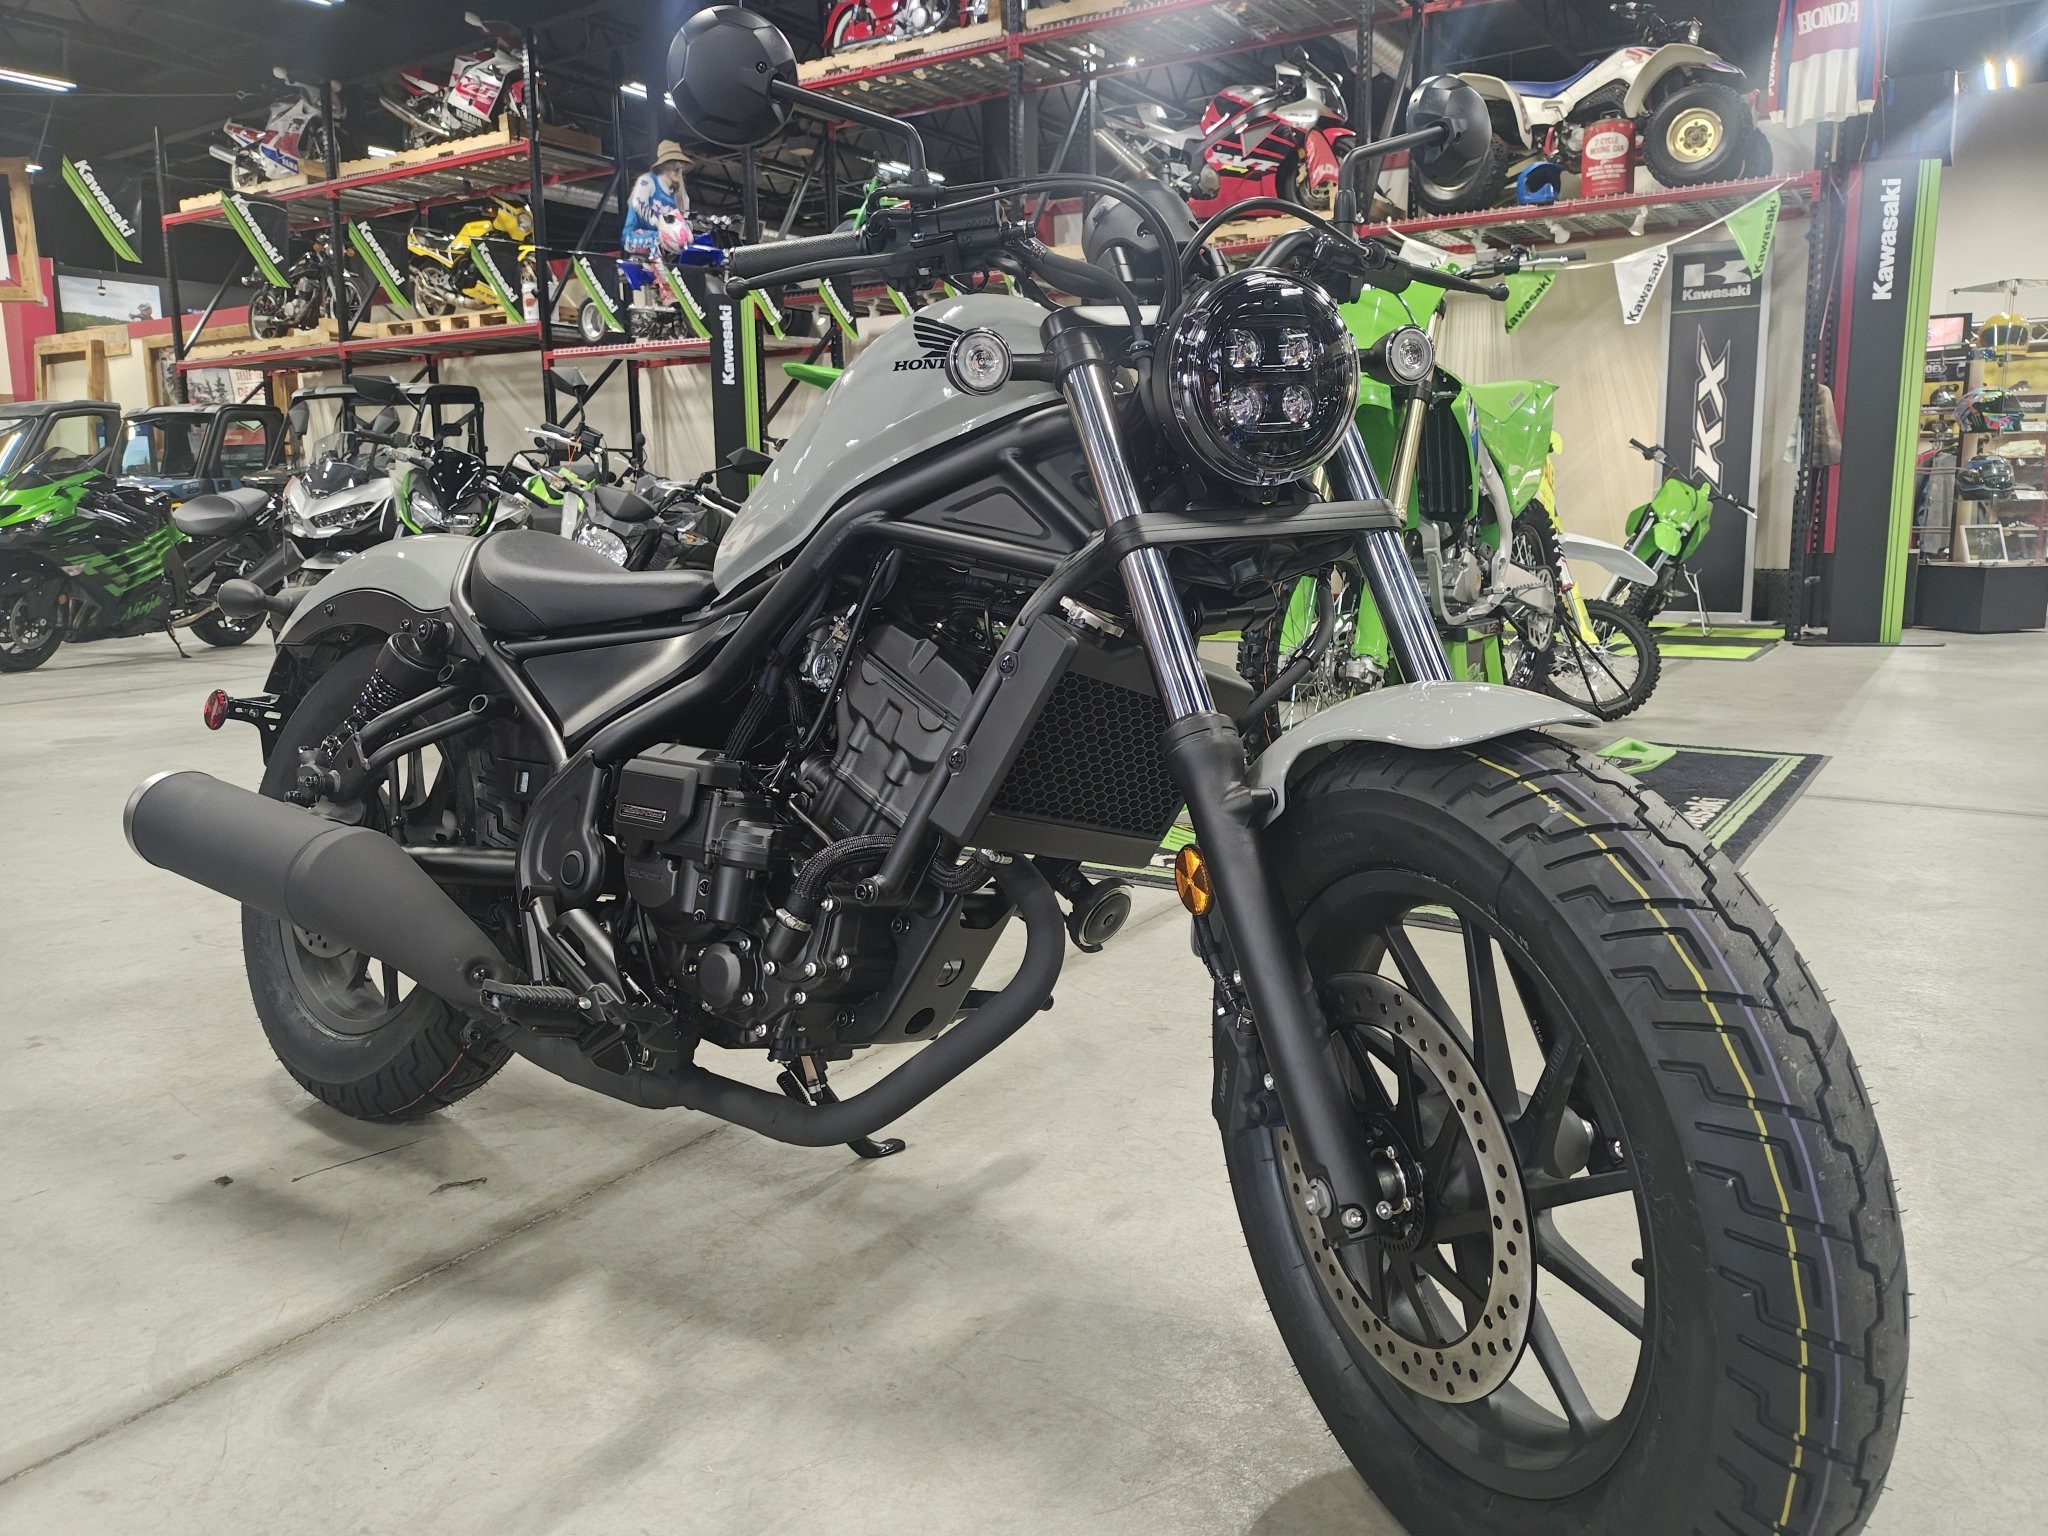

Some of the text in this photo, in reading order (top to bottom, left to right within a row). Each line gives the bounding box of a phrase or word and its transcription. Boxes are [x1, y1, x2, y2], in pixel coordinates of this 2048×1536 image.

[1797, 0, 1858, 35] HONDA
[74, 159, 136, 238] Kawasaki
[230, 193, 284, 265] Kawasaki
[357, 221, 406, 286] Kawasaki
[1753, 200, 1777, 274] Kawasaki
[1872, 178, 1902, 300] Kawasaki
[477, 242, 519, 303] Kawasaki
[580, 257, 619, 313] Kawasaki
[671, 266, 707, 320] Kawasaki
[823, 278, 854, 324] Kawasaki
[1626, 253, 1666, 322] Kawasaki
[1682, 284, 1751, 302] Kawasaki
[719, 304, 736, 386] Kawasaki
[893, 359, 946, 372] HON
[1690, 326, 1730, 493] KX
